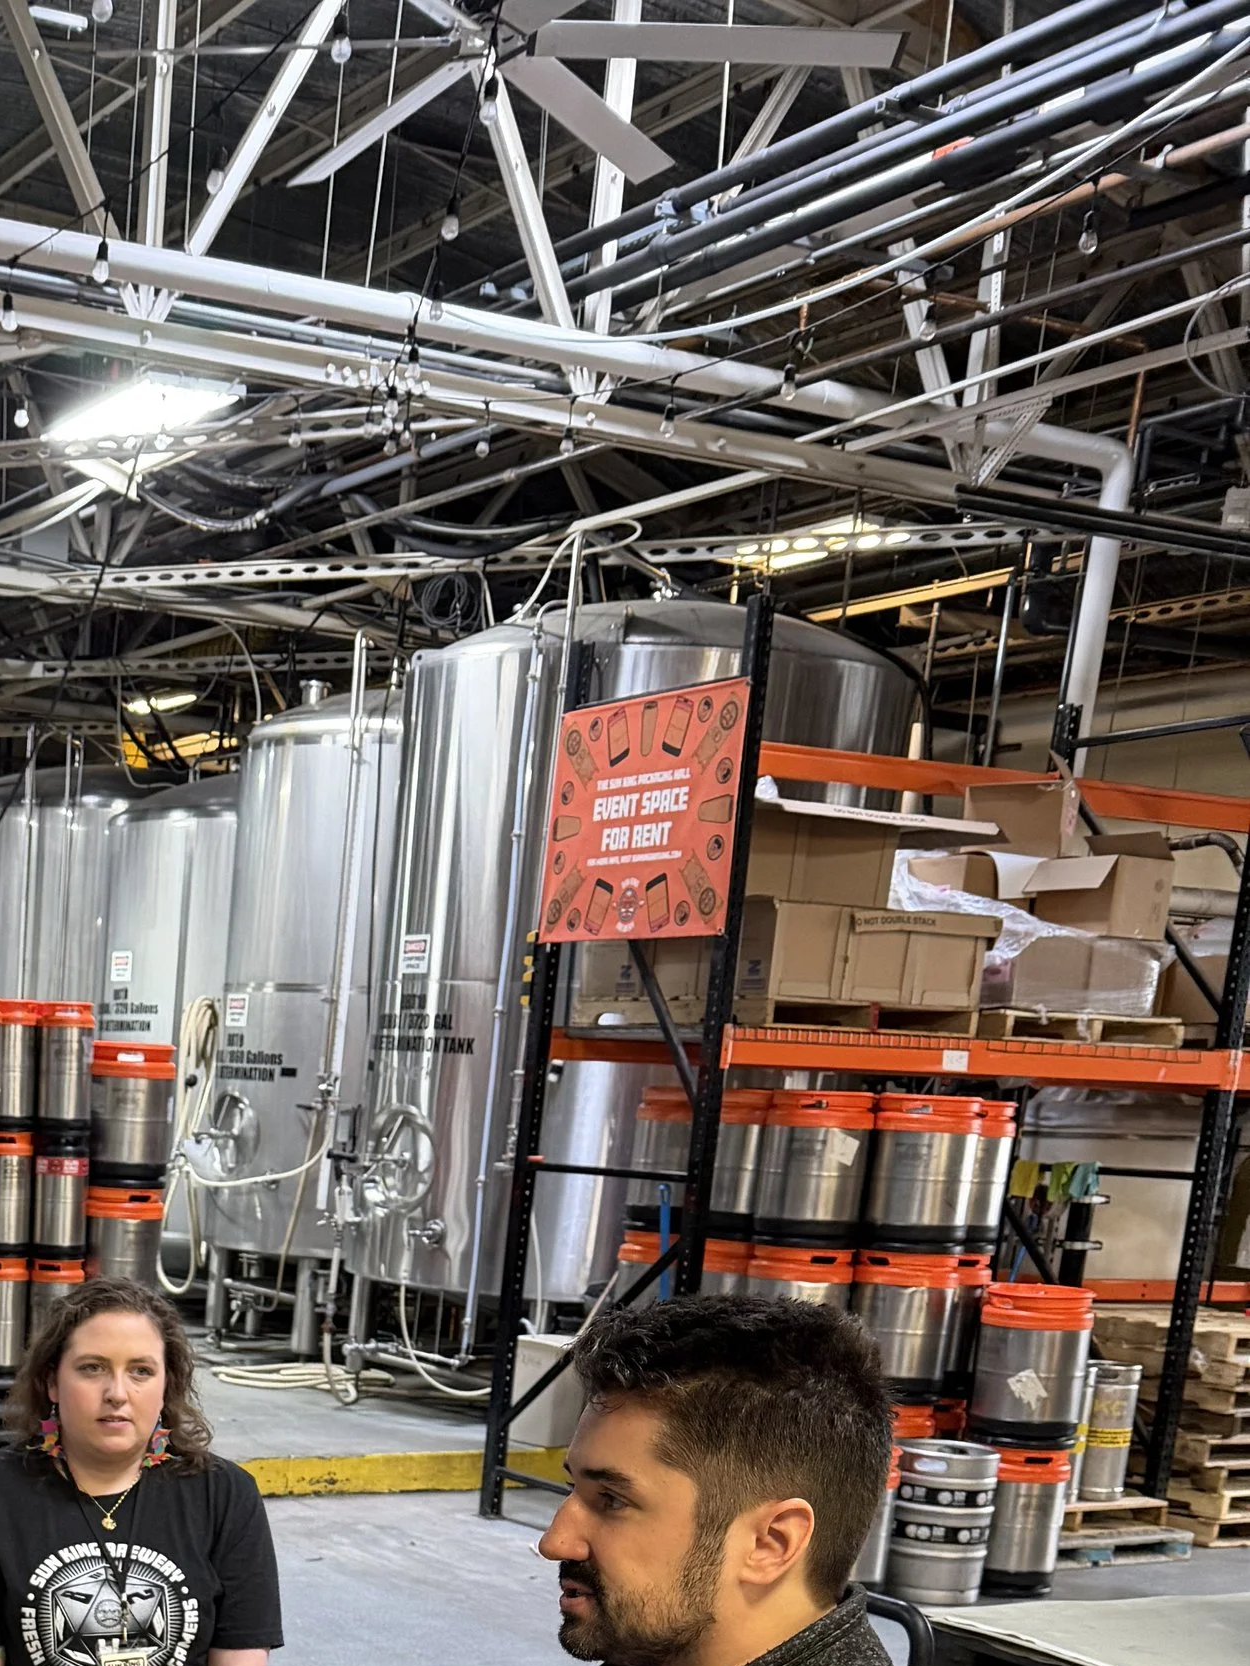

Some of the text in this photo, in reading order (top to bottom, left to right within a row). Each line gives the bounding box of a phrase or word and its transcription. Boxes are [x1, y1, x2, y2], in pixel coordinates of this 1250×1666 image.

[593, 786, 690, 822] EVENT SPACE
[600, 821, 673, 852] FOR RENT
[864, 917, 878, 925] NOT
[881, 916, 912, 925] DOUBLE
[912, 917, 937, 926] STACK
[433, 1013, 453, 1030] GAL
[246, 1050, 283, 1066] Gallons
[443, 1037, 476, 1055] TANK
[29, 1554, 64, 1590] SUN
[58, 1542, 102, 1564] KING
[21, 1606, 46, 1666] FRESH
